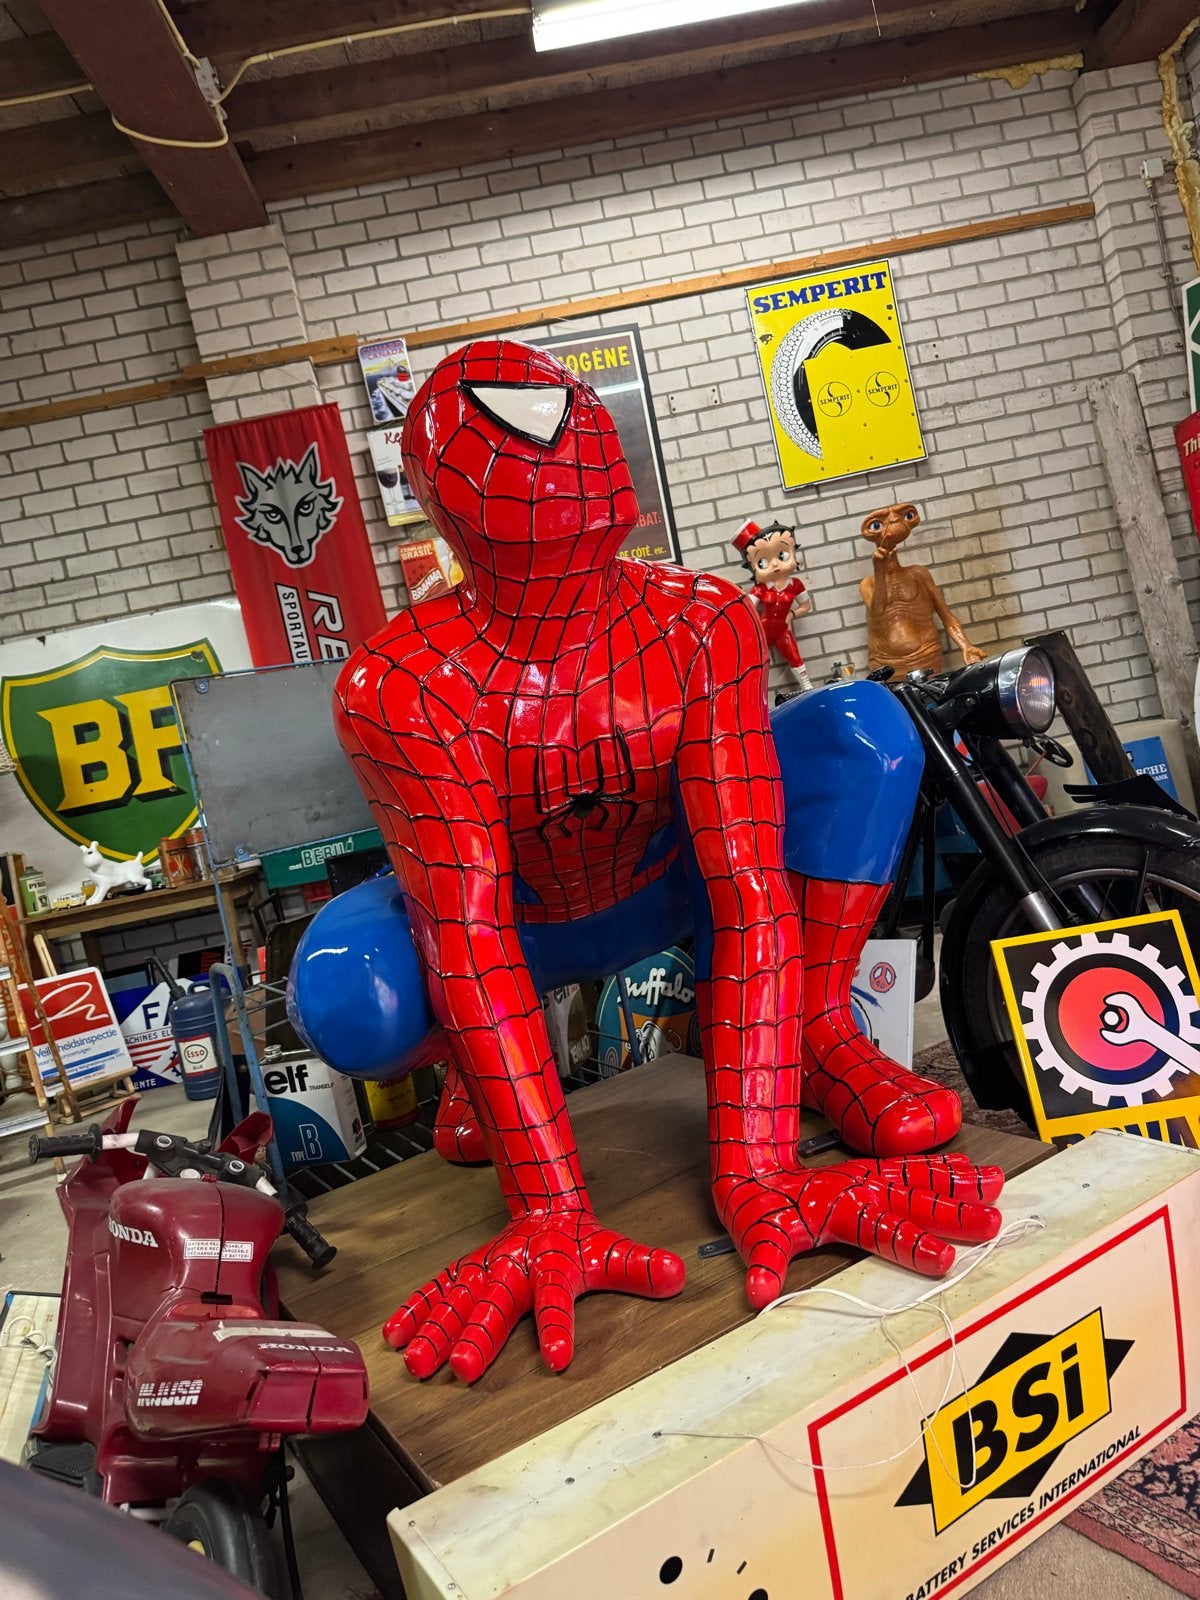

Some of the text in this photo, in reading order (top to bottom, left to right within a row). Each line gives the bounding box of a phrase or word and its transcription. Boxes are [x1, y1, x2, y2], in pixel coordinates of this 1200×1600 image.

[753, 271, 887, 315] SEMPERIT
[367, 348, 405, 360] CANADA
[558, 344, 631, 373] OGÈNE
[820, 393, 850, 405] SEMPERIT
[868, 383, 898, 395] SEMPERIT
[635, 511, 662, 528] BAT:
[401, 548, 433, 560] BRASIL
[411, 569, 443, 601] BRAHMA
[34, 1028, 118, 1059] Veilheidsinspectie
[263, 1063, 310, 1096] elf
[309, 1081, 335, 1091] TRANSELF
[290, 1123, 323, 1163] TYPE B
[257, 1342, 354, 1354] HONDA
[971, 1502, 1035, 1561] SERVICES
[1039, 1425, 1142, 1512] INTERNATIONAL
